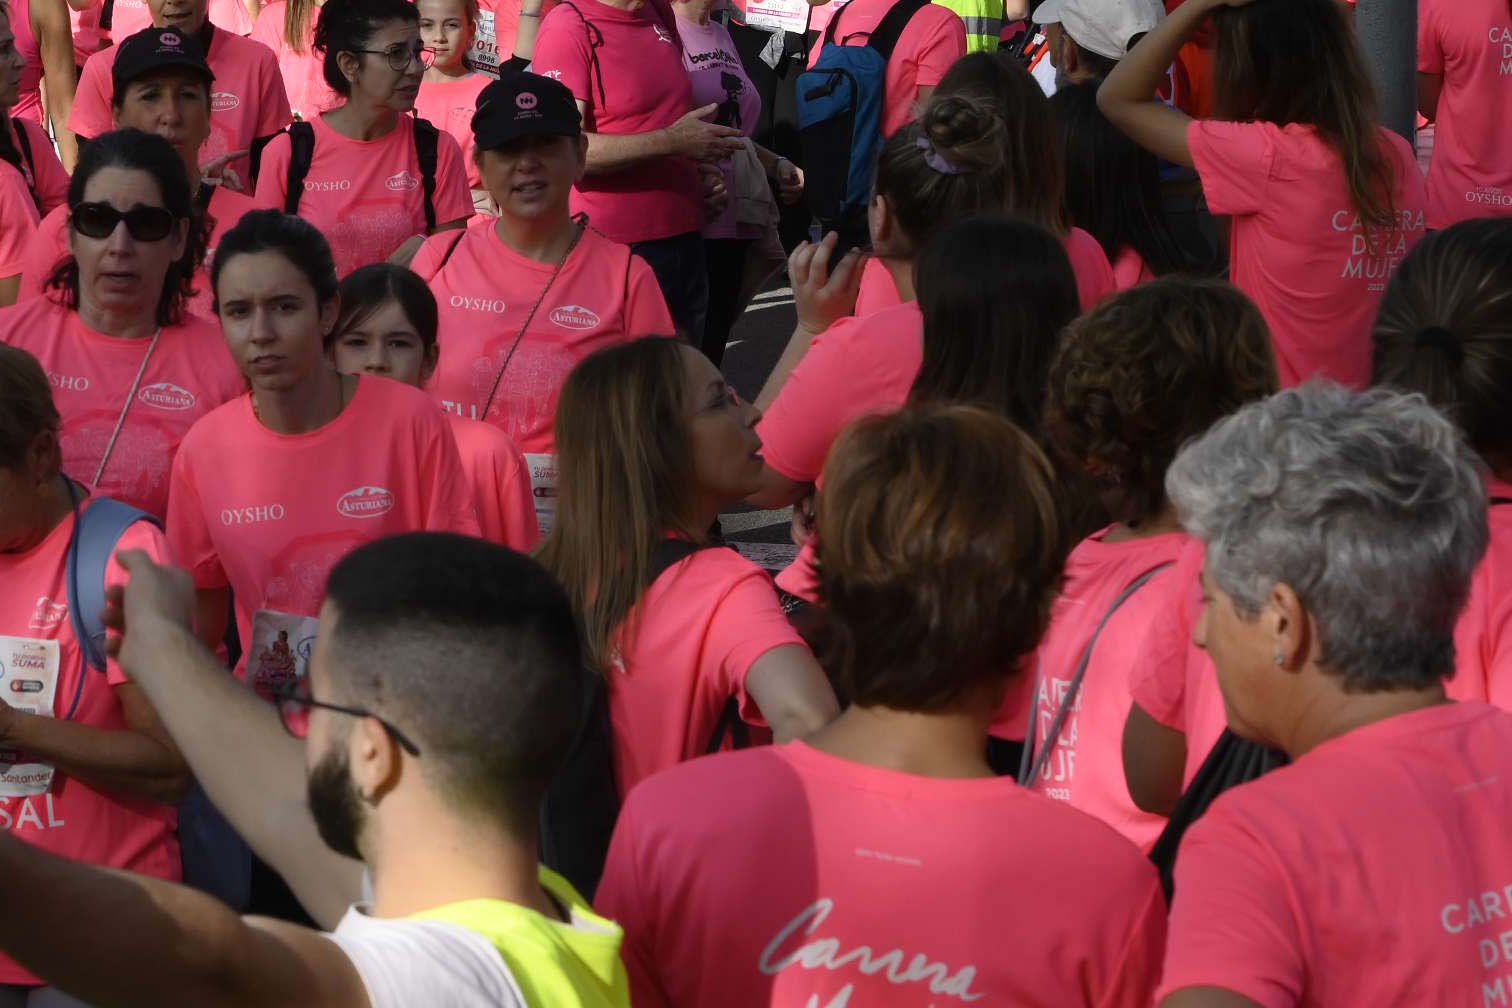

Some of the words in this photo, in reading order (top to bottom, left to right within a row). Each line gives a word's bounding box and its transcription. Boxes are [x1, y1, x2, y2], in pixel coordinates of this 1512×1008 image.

[304, 179, 351, 192] OYSHO
[450, 295, 506, 314] OYSHO
[221, 504, 285, 525] OYSHO
[12, 660, 46, 671] SUMA
[756, 898, 983, 1001] Carrera
